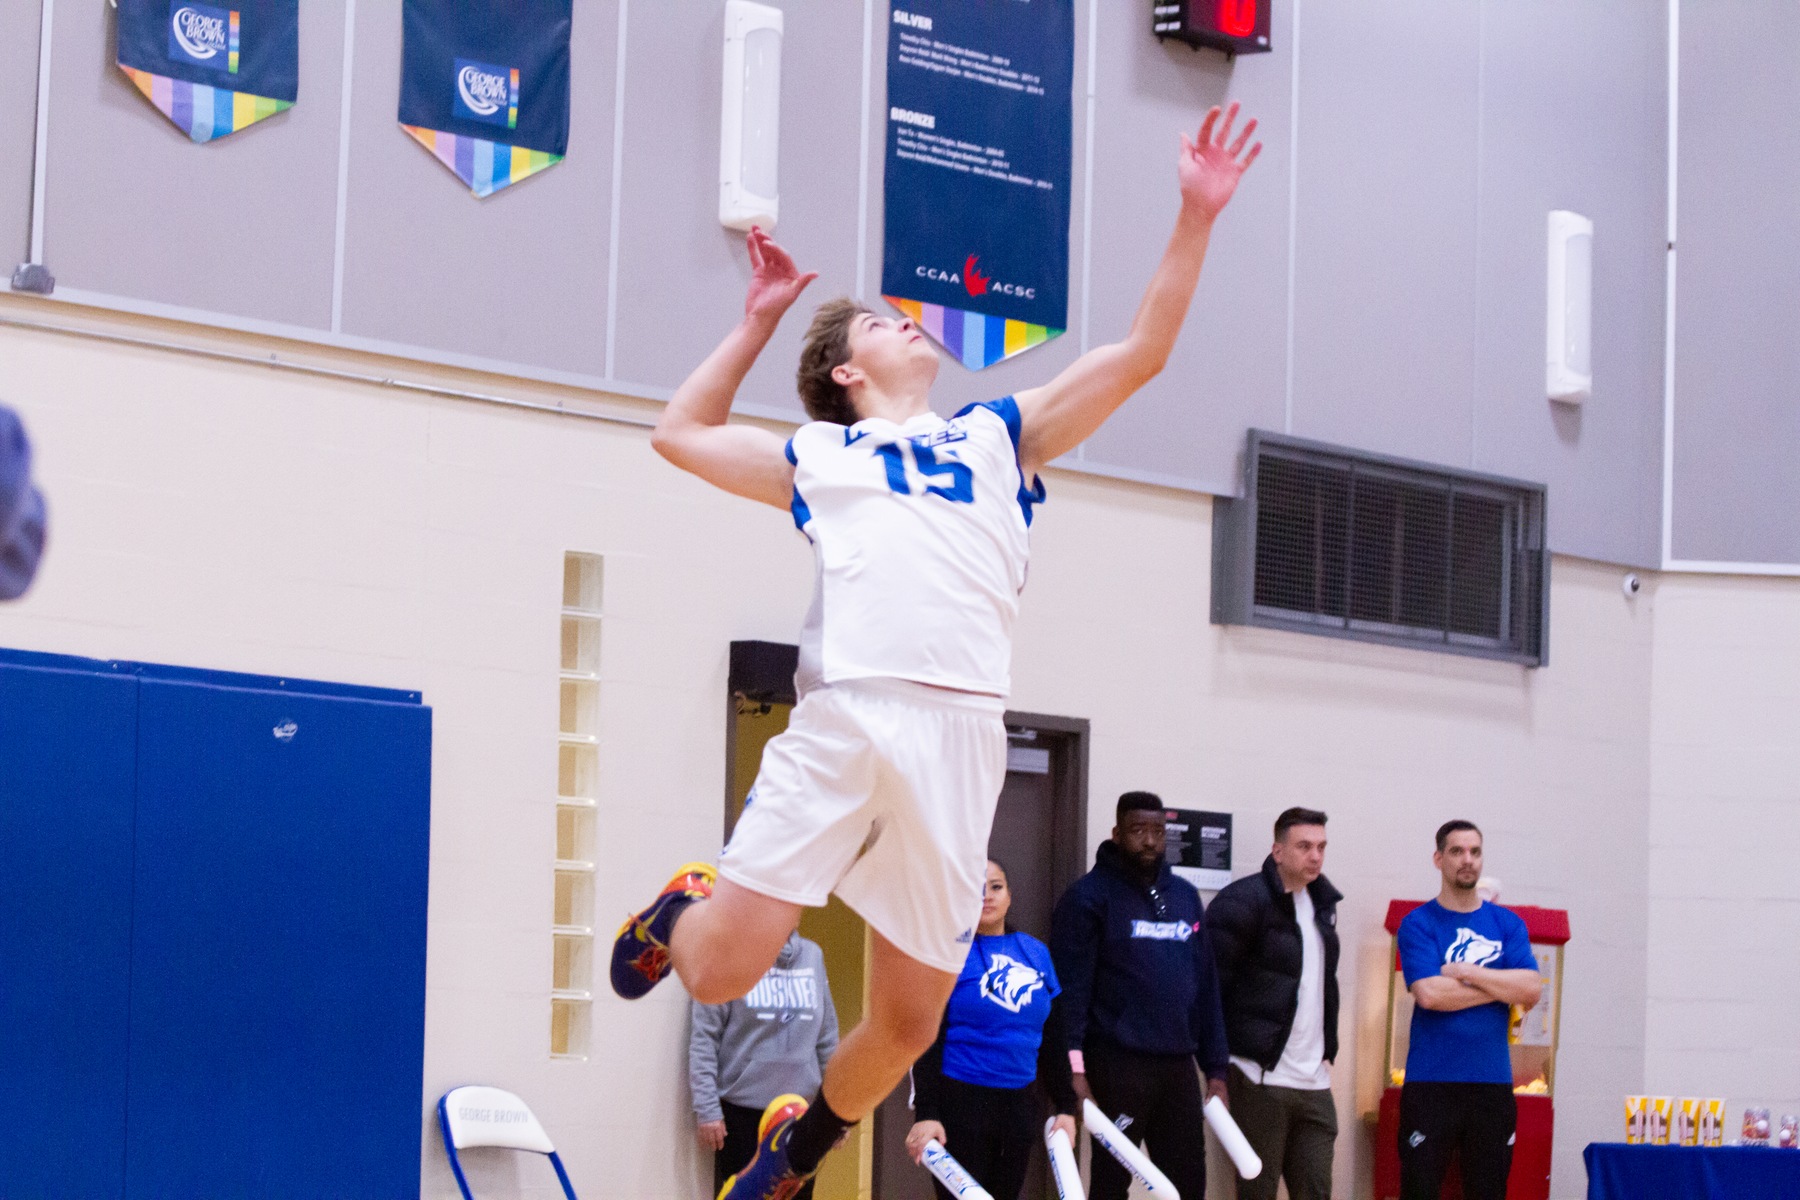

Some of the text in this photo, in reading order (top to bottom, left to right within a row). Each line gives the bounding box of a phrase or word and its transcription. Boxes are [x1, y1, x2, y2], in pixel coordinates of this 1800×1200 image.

[181, 11, 223, 30] GEORGE
[893, 9, 933, 31] SILVER
[186, 25, 225, 44] BROWN
[890, 107, 935, 129] BRONZE
[915, 265, 1036, 299] CCAA ACSC
[872, 440, 974, 503] 15
[458, 1107, 529, 1124] GEORGE BROWN
